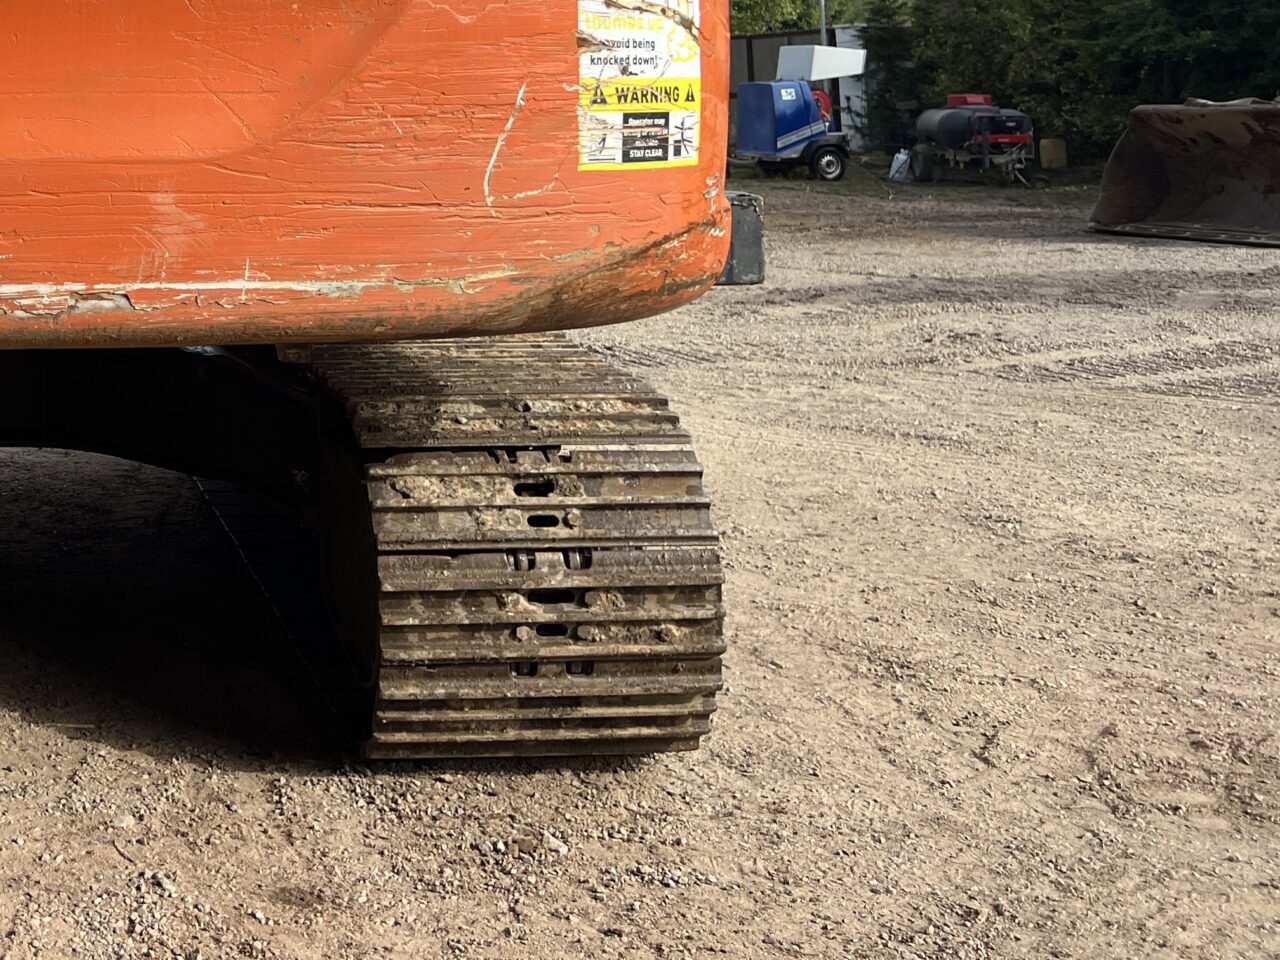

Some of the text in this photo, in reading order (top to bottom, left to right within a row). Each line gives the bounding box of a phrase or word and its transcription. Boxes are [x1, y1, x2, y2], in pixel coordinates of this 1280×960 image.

[632, 38, 656, 51] being
[590, 54, 630, 66] knocked
[614, 86, 680, 105] WARNING
[629, 149, 663, 158] STAY CLEAR
